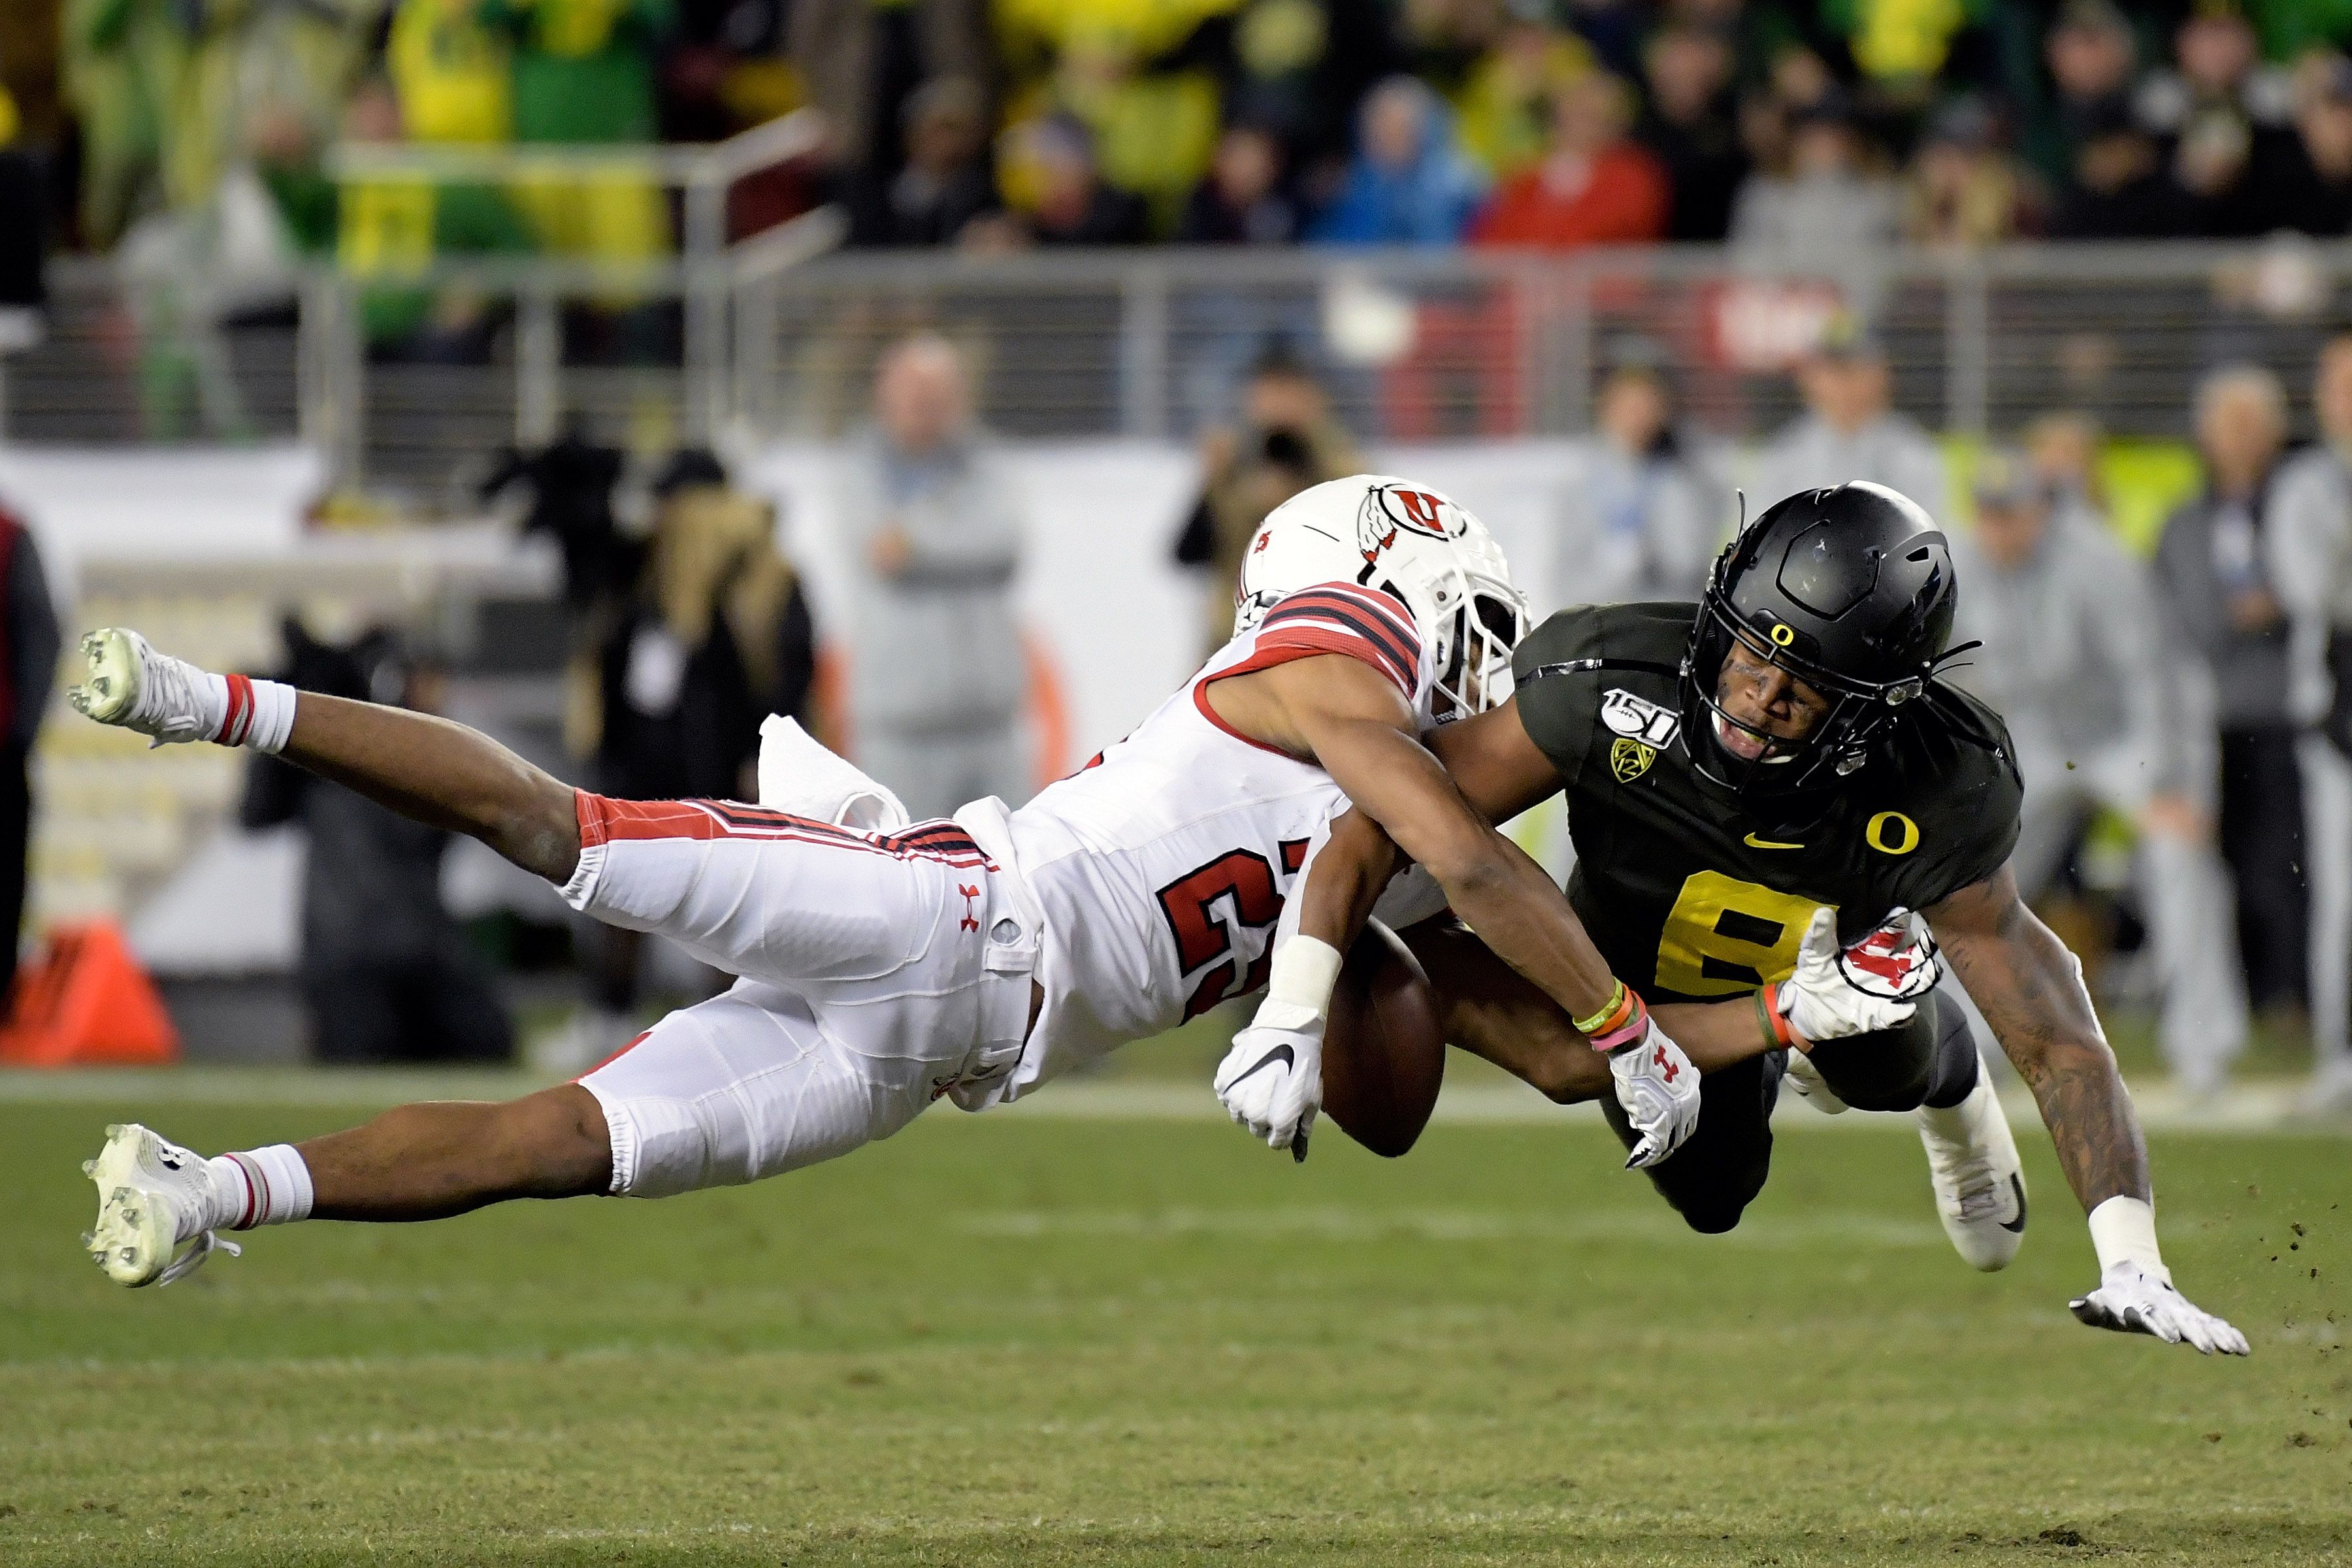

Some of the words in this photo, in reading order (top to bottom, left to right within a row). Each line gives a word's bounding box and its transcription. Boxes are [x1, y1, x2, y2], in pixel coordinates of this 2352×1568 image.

[1390, 490, 1446, 533] U
[1771, 624, 1794, 646] O
[1603, 689, 1680, 749] 150
[1614, 739, 1654, 771] PAC
[1617, 758, 1638, 776] 12
[1866, 811, 1919, 855] O
[1655, 870, 1840, 996] 8
